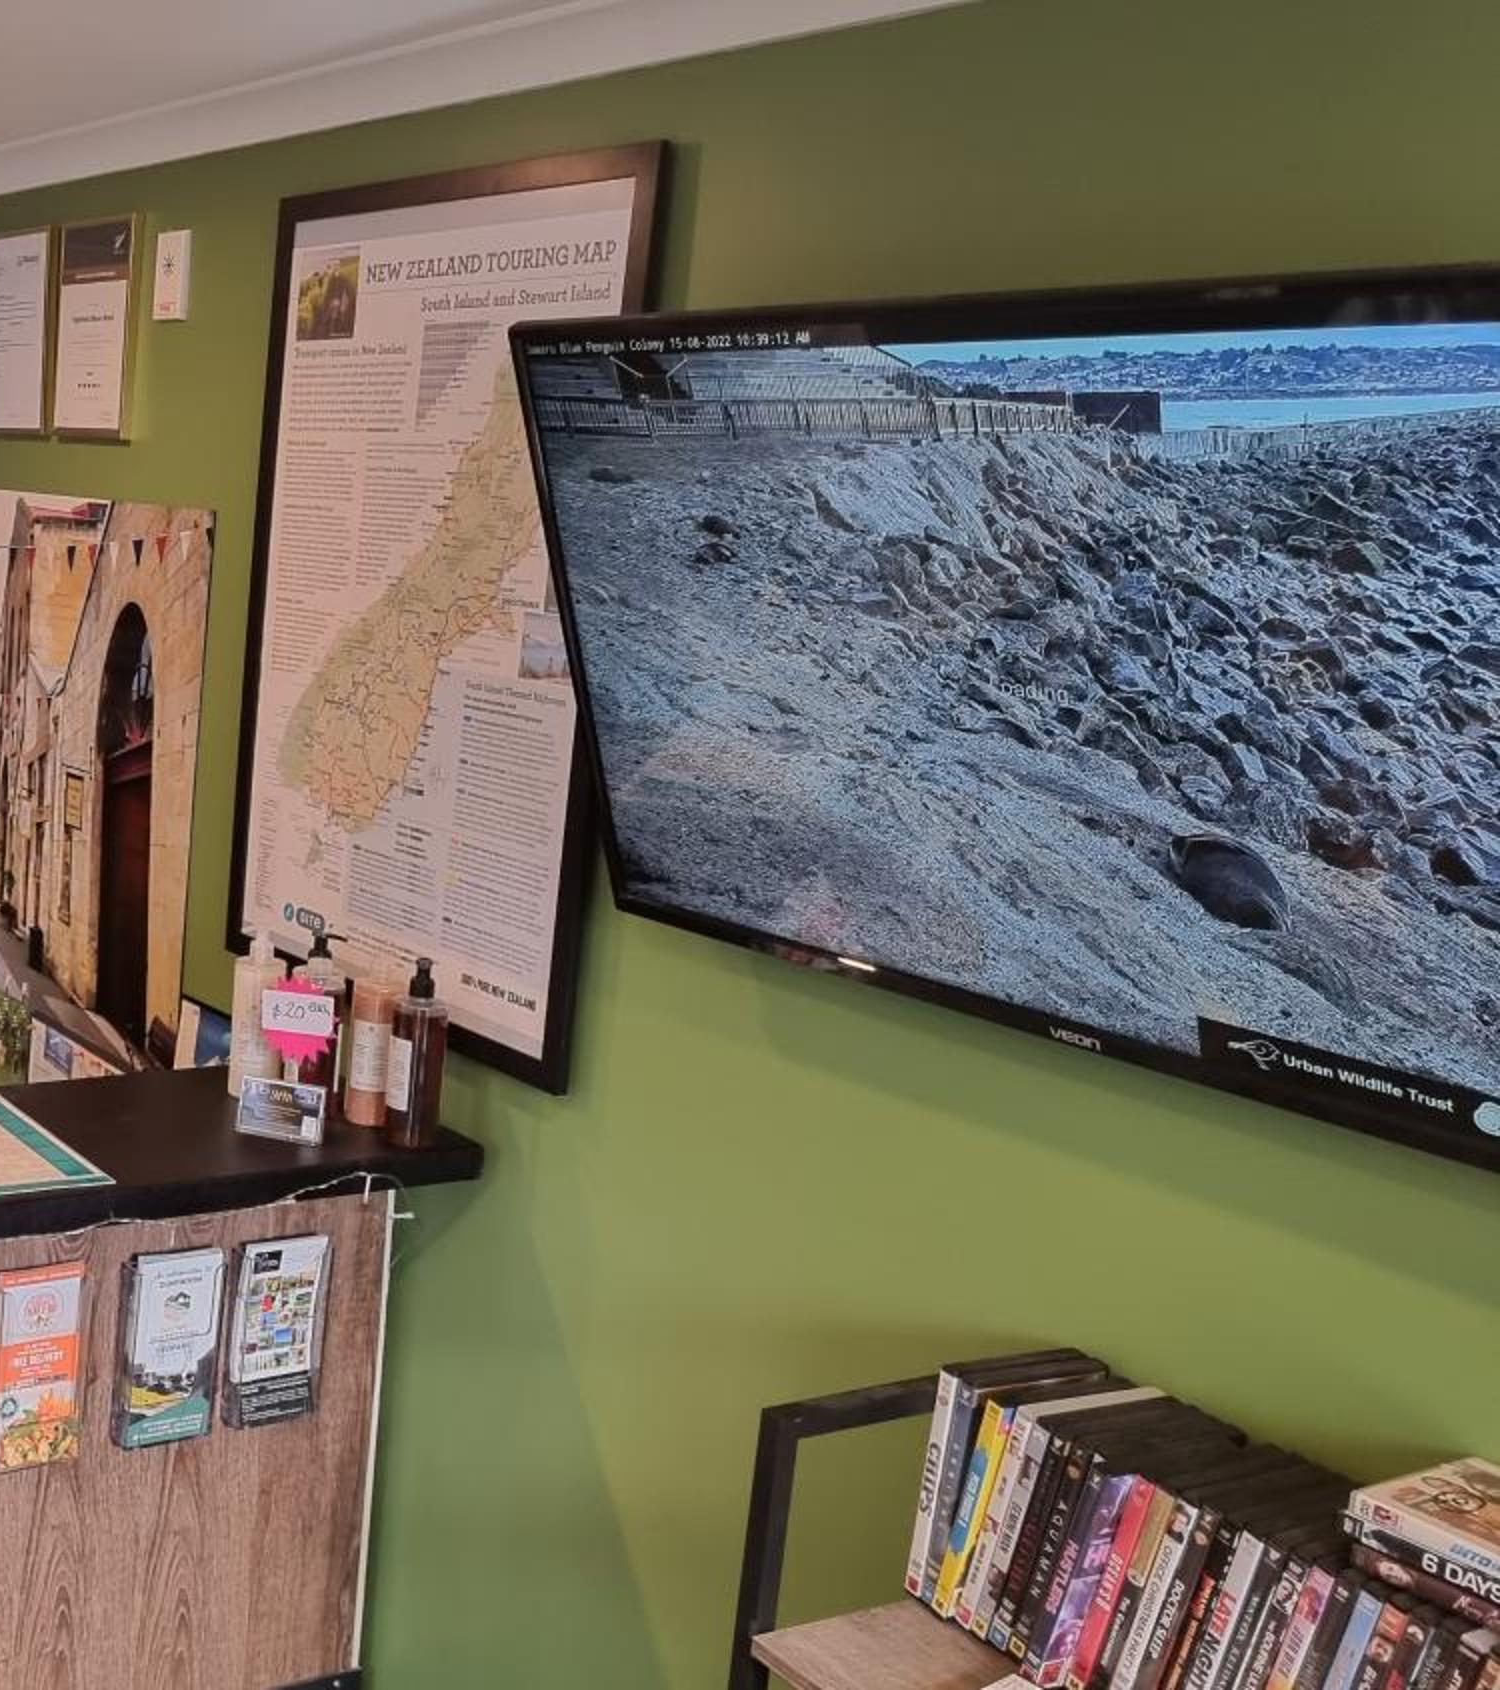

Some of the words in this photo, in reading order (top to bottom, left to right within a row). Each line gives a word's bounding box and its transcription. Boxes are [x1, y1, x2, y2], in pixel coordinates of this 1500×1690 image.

[366, 262, 403, 284] NEW
[406, 254, 482, 280] ZEALAND
[486, 247, 569, 272] TOURING
[573, 240, 617, 265] MAP
[420, 296, 450, 312] South
[454, 291, 489, 309] Island
[493, 289, 515, 306] and
[518, 288, 567, 305] Stewart
[571, 281, 611, 301] Island
[629, 339, 664, 352] Colony
[272, 1003, 305, 1020] $20
[1283, 1052, 1333, 1078] Urban
[1338, 1067, 1403, 1098] Wildlife
[1407, 1087, 1455, 1113] Trust
[918, 1442, 941, 1520] CHIPS
[1029, 1500, 1068, 1598] AQUAMAN
[1045, 1537, 1080, 1615] HUSTLERS
[1421, 1553, 1439, 1572] 6
[1445, 1566, 1500, 1605] DAYS
[1160, 1577, 1185, 1629] DOCTOR
[1208, 1589, 1236, 1637] LATE
[1149, 1625, 1167, 1660] SLEEP
